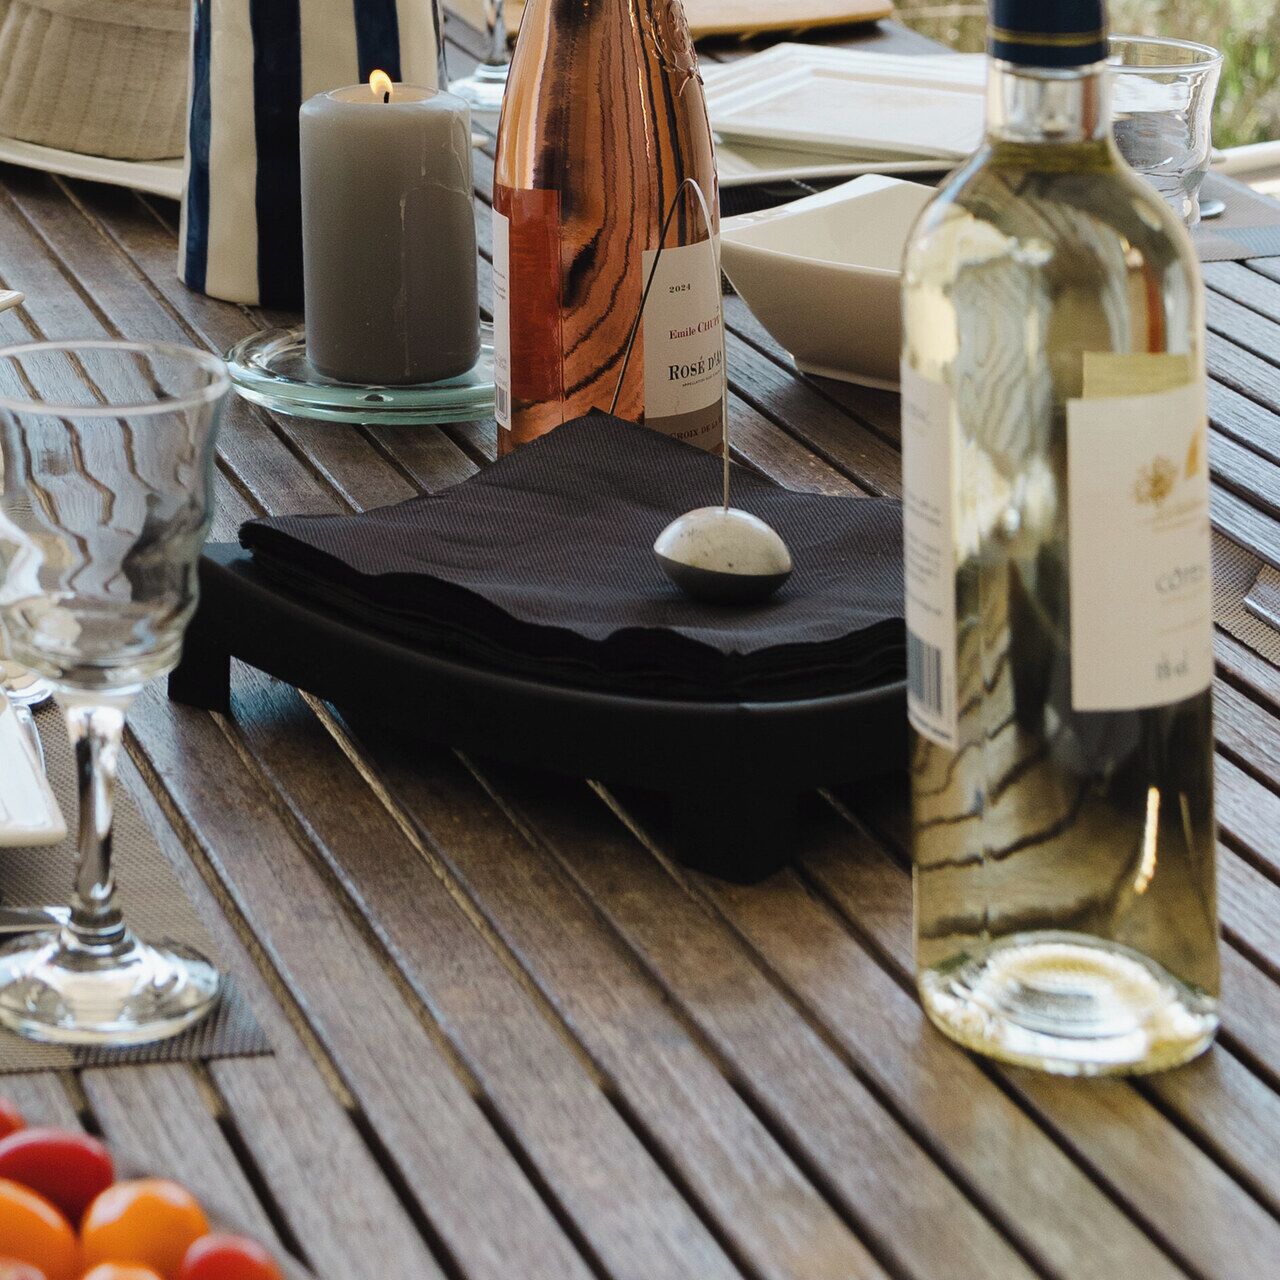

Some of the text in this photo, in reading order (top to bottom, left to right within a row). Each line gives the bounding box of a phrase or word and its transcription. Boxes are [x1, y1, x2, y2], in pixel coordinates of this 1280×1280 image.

[669, 283, 691, 293] 2024
[669, 326, 696, 339] Emile
[667, 355, 705, 380] ROSÉ
